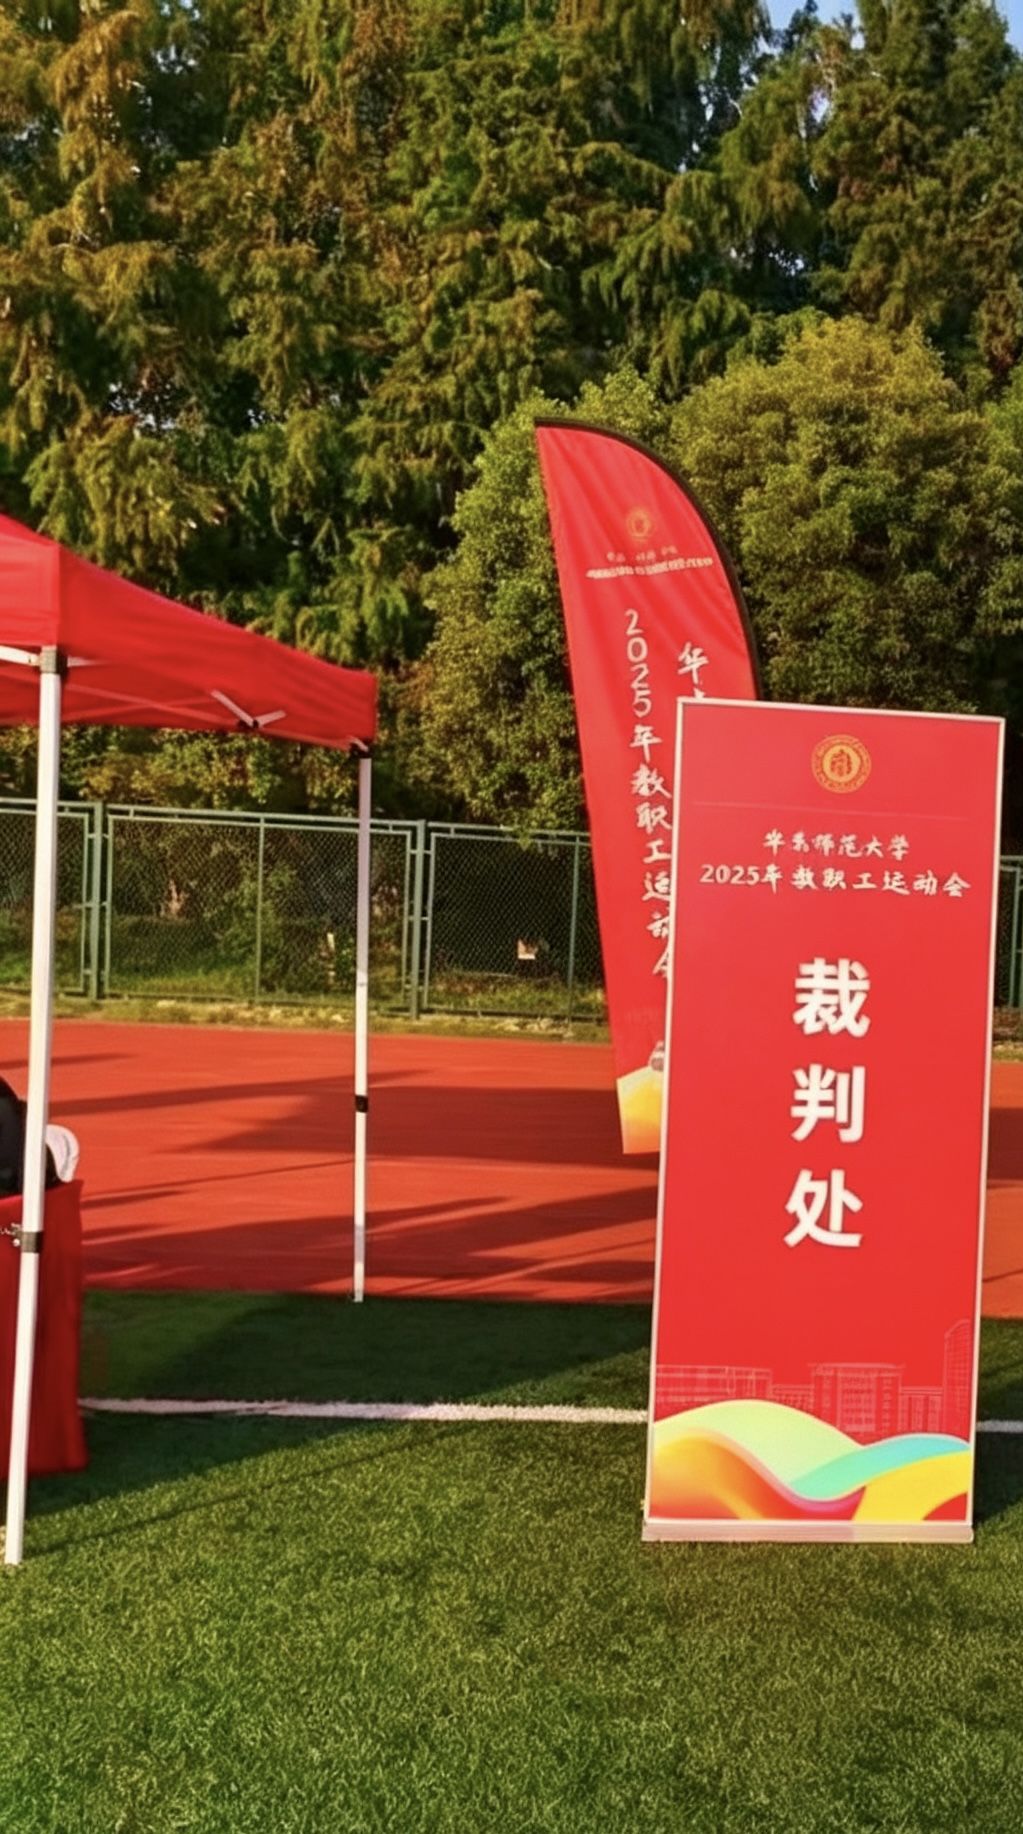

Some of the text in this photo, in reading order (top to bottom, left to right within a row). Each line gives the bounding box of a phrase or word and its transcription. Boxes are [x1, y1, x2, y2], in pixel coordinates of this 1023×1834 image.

[678, 641, 709, 698] 华
[763, 829, 910, 861] 华东师范大学
[699, 863, 972, 898] 2025年教职工运动会
[783, 956, 871, 1248] 裁判处
